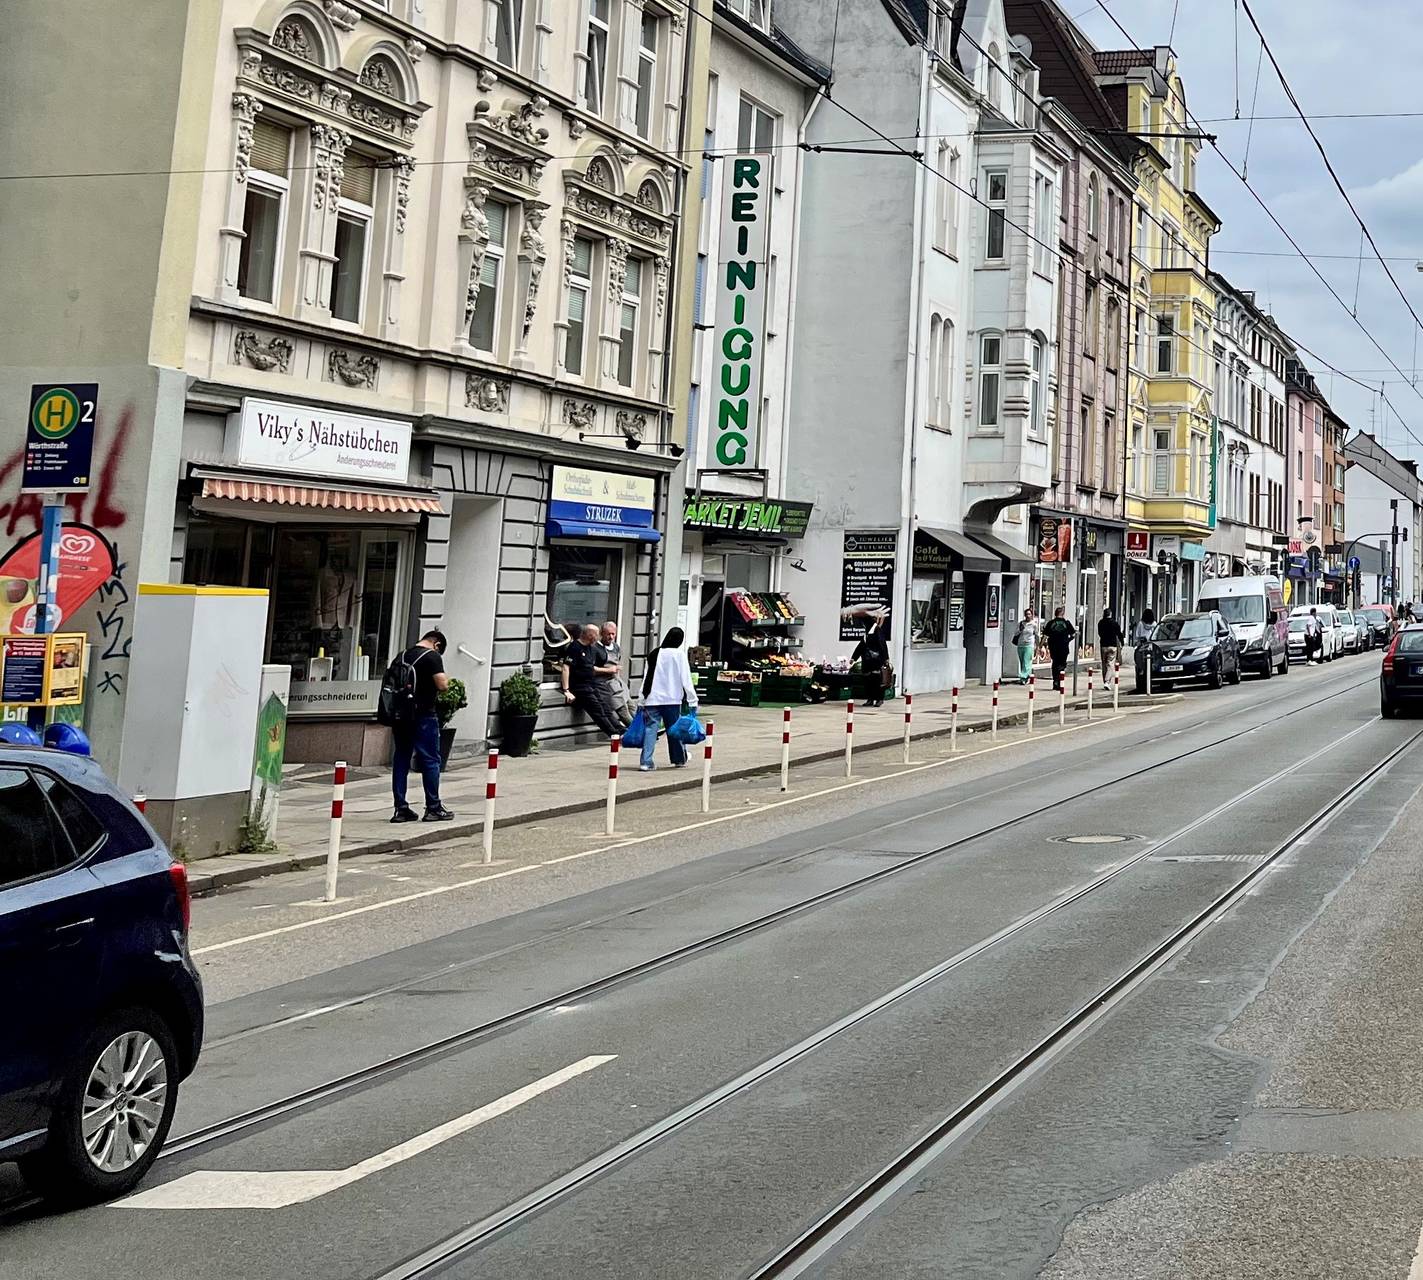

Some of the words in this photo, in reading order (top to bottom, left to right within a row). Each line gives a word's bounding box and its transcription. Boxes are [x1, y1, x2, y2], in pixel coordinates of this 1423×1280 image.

[715, 157, 761, 467] REINIGUNG
[81, 401, 94, 422] 2
[308, 420, 399, 454] Nähstübchen
[602, 480, 609, 495] &
[586, 505, 623, 522] STRUZEK
[683, 500, 740, 528] ARKET
[738, 501, 783, 533] JEMIL
[914, 546, 939, 554] Gold
[289, 691, 368, 703] erungsschneiderei
